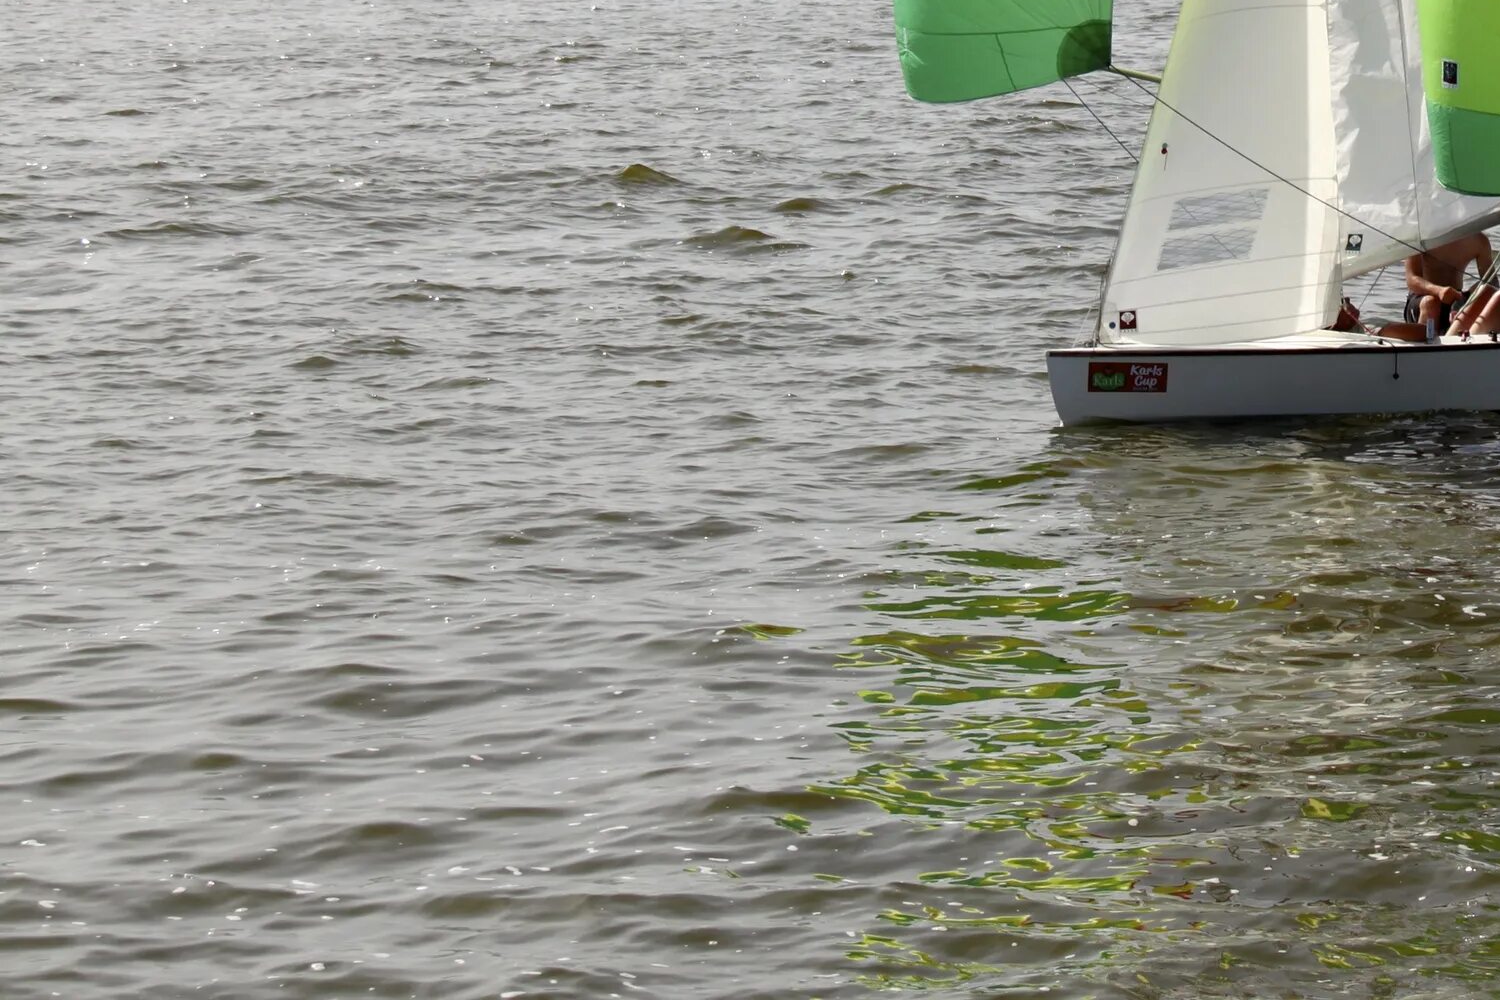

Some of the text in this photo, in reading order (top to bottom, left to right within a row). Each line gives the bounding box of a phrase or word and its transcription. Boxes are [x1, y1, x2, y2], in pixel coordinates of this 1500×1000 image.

[1130, 364, 1164, 377] Karls
[1092, 374, 1125, 387] Karls
[1134, 375, 1158, 389] Cup
